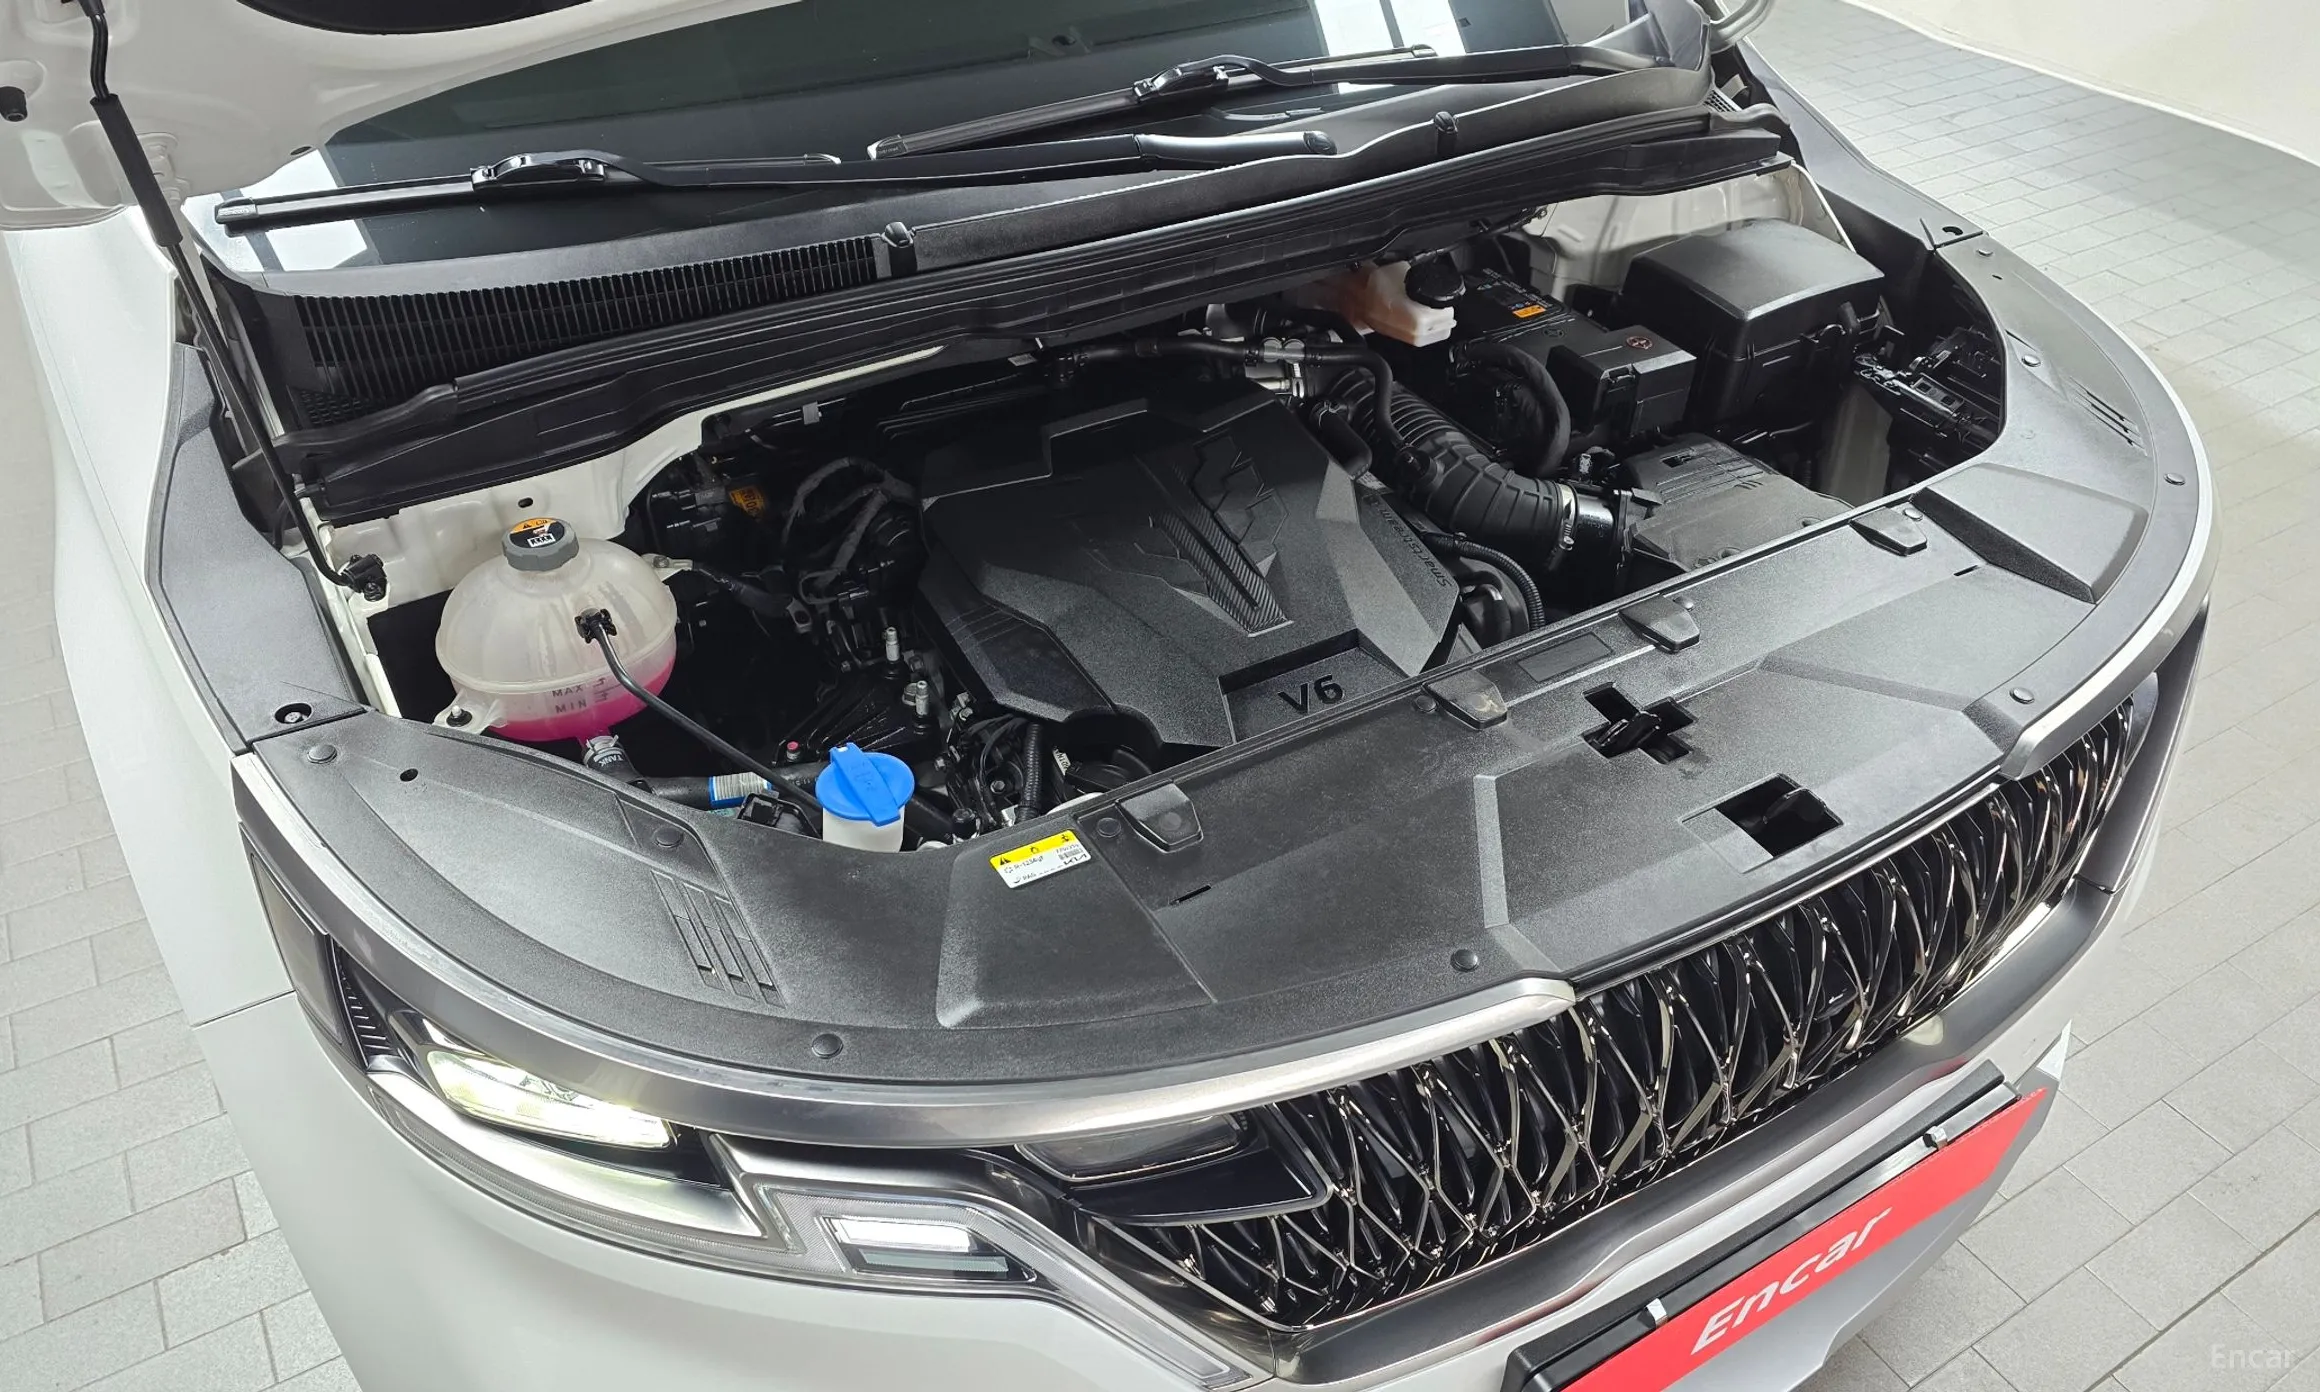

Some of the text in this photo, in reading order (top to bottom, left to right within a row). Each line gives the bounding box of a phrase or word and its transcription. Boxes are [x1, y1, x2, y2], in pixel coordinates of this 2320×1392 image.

[552, 684, 583, 698] MAX
[1277, 674, 1343, 715] V6
[555, 699, 587, 714] MIN
[599, 754, 624, 767] TANK
[1689, 1206, 1894, 1356] Encar
